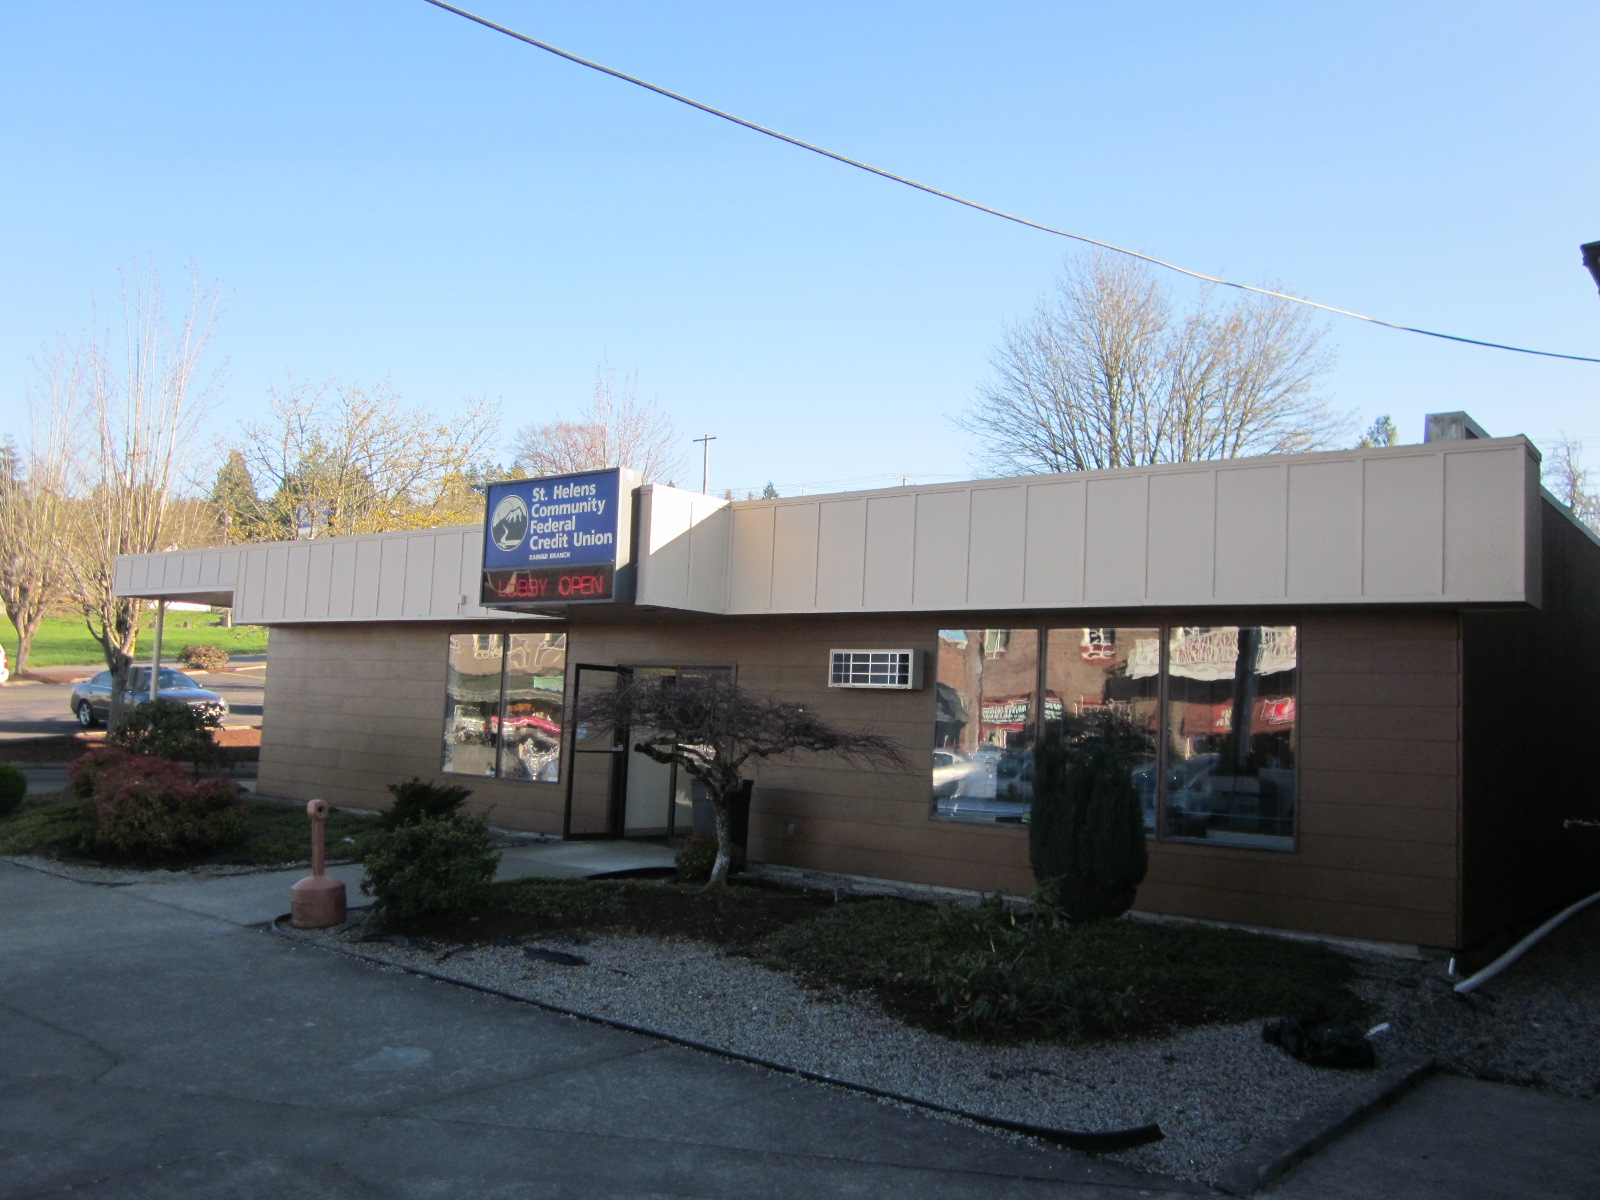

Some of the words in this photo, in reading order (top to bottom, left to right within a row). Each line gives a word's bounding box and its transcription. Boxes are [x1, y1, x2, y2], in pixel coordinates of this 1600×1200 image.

[532, 487, 548, 502] St.
[553, 483, 596, 500] Helens
[531, 498, 606, 518] Community
[530, 515, 576, 534] Federal
[529, 532, 568, 551] Credit
[573, 530, 613, 547] Union
[498, 578, 548, 598] LOBBY
[558, 575, 604, 596] OPEN
